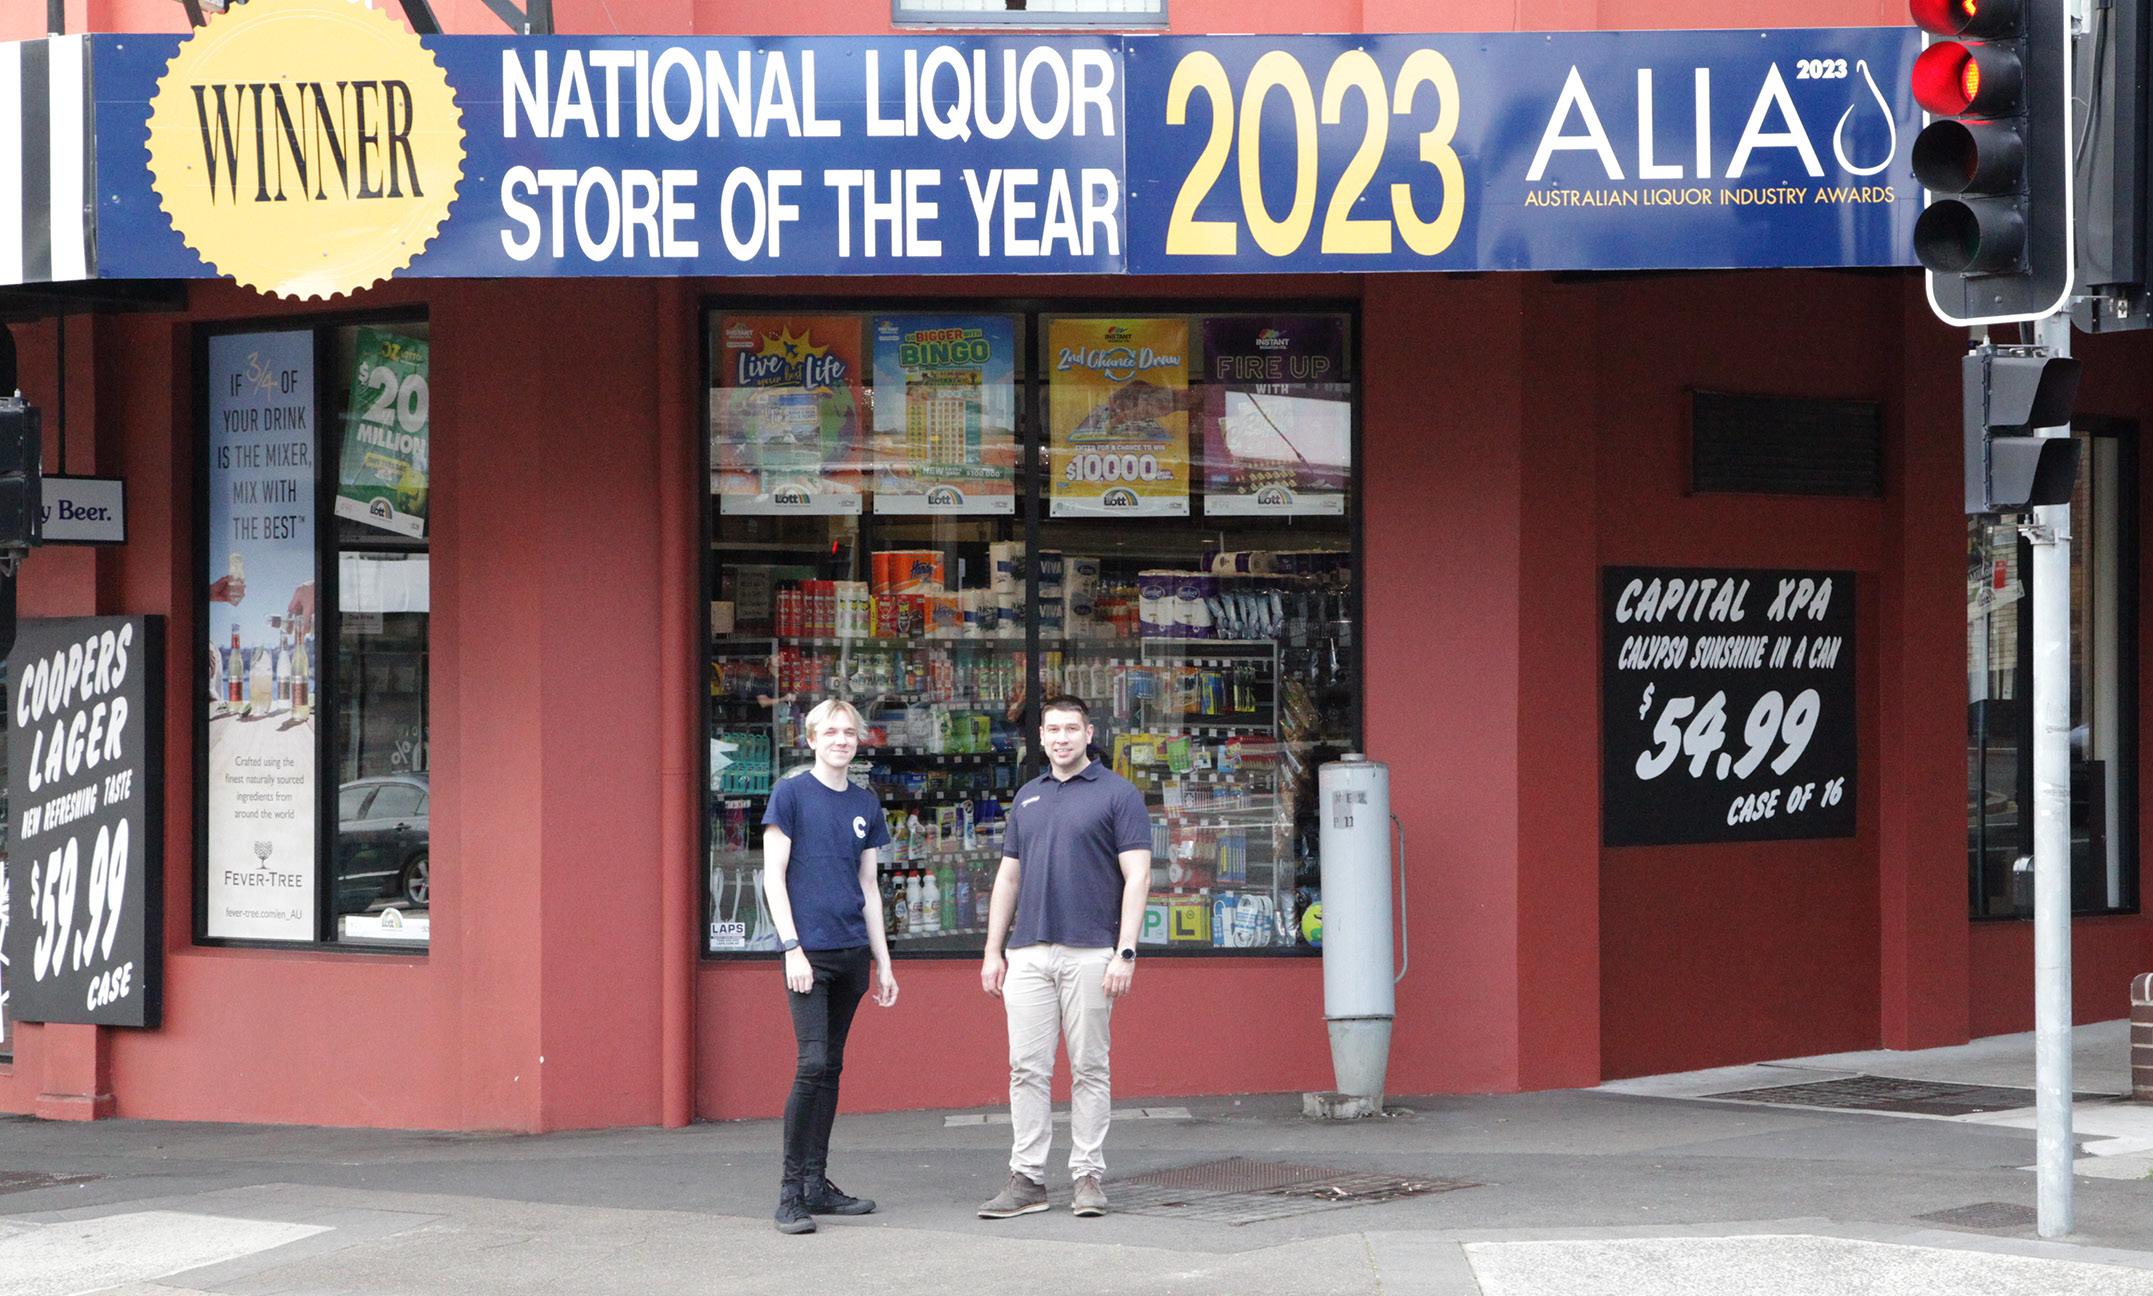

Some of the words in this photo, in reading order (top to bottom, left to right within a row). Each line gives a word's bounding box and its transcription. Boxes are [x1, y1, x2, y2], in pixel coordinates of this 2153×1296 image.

[1796, 58, 1848, 80] 2023
[502, 46, 842, 142] NATIONAL
[865, 45, 1116, 143] LIQUOR
[1525, 61, 1825, 181] ALIA
[190, 79, 424, 207] WINNER
[1165, 48, 1466, 257] 2023
[1525, 189, 1638, 208] AUSTRALIAN
[1644, 188, 1712, 206] LIQUOR
[1720, 187, 1807, 206] INDUSTRY
[1814, 186, 1895, 204] AWARDS
[500, 165, 699, 262] STORE
[720, 165, 802, 262] OF
[824, 169, 943, 258] THE
[963, 168, 1120, 257] YEAR
[916, 328, 963, 343] BIGGER
[1255, 338, 1290, 346] INSTANT
[900, 339, 991, 367] BINGO
[1057, 346, 1084, 371] 2nd
[1087, 347, 1137, 370] Chance
[1139, 347, 1181, 371] Draw
[739, 352, 783, 385] Live
[806, 355, 845, 389] Life
[1216, 355, 1284, 380] FIRE
[1289, 355, 1331, 380] UP
[230, 373, 242, 397] IF
[281, 370, 298, 394] OF
[1255, 383, 1289, 394] WITH
[224, 409, 258, 433] YOUR
[264, 406, 306, 431] DRINK
[356, 422, 427, 456] MILLION
[217, 446, 230, 469] IS
[235, 444, 260, 468] THE
[265, 442, 312, 469] MIXER,
[233, 480, 258, 504] MIX
[262, 479, 296, 503] WITH
[58, 499, 112, 521] Beer.
[233, 516, 258, 540] THE
[1040, 560, 1062, 574] VIVA
[1039, 604, 1063, 618] VIVA
[1615, 577, 1750, 624] CAPITAL
[1766, 577, 1833, 622] XPA
[1618, 635, 1689, 670] CALYPSO
[1689, 635, 1769, 670] SUNSHINE
[1769, 636, 1791, 669] IN
[1792, 635, 1808, 669] A
[1808, 635, 1843, 670] CAN
[17, 622, 133, 728] COOPERS
[28, 696, 128, 792] LAGER
[1635, 681, 1821, 781] $54.99
[234, 755, 261, 767] Crafted
[263, 756, 281, 770] using
[282, 756, 295, 767] the
[225, 773, 244, 784] finest
[246, 774, 275, 787] naturally
[276, 774, 304, 785] sourced
[21, 805, 42, 840] NEW
[43, 783, 98, 832] REFRESHING
[103, 768, 133, 806] TASTE
[236, 791, 274, 803] ingredients
[275, 791, 292, 801] from
[1727, 788, 1781, 826] CASE
[1786, 782, 1816, 814] OF
[1820, 776, 1845, 808] 16
[234, 809, 259, 819] around
[260, 808, 273, 819] the
[274, 809, 295, 819] world
[31, 817, 129, 982] $59.99
[712, 924, 744, 934] LAPS
[1144, 910, 1161, 938] P
[1176, 910, 1195, 937] L
[87, 961, 133, 1011] CASE
